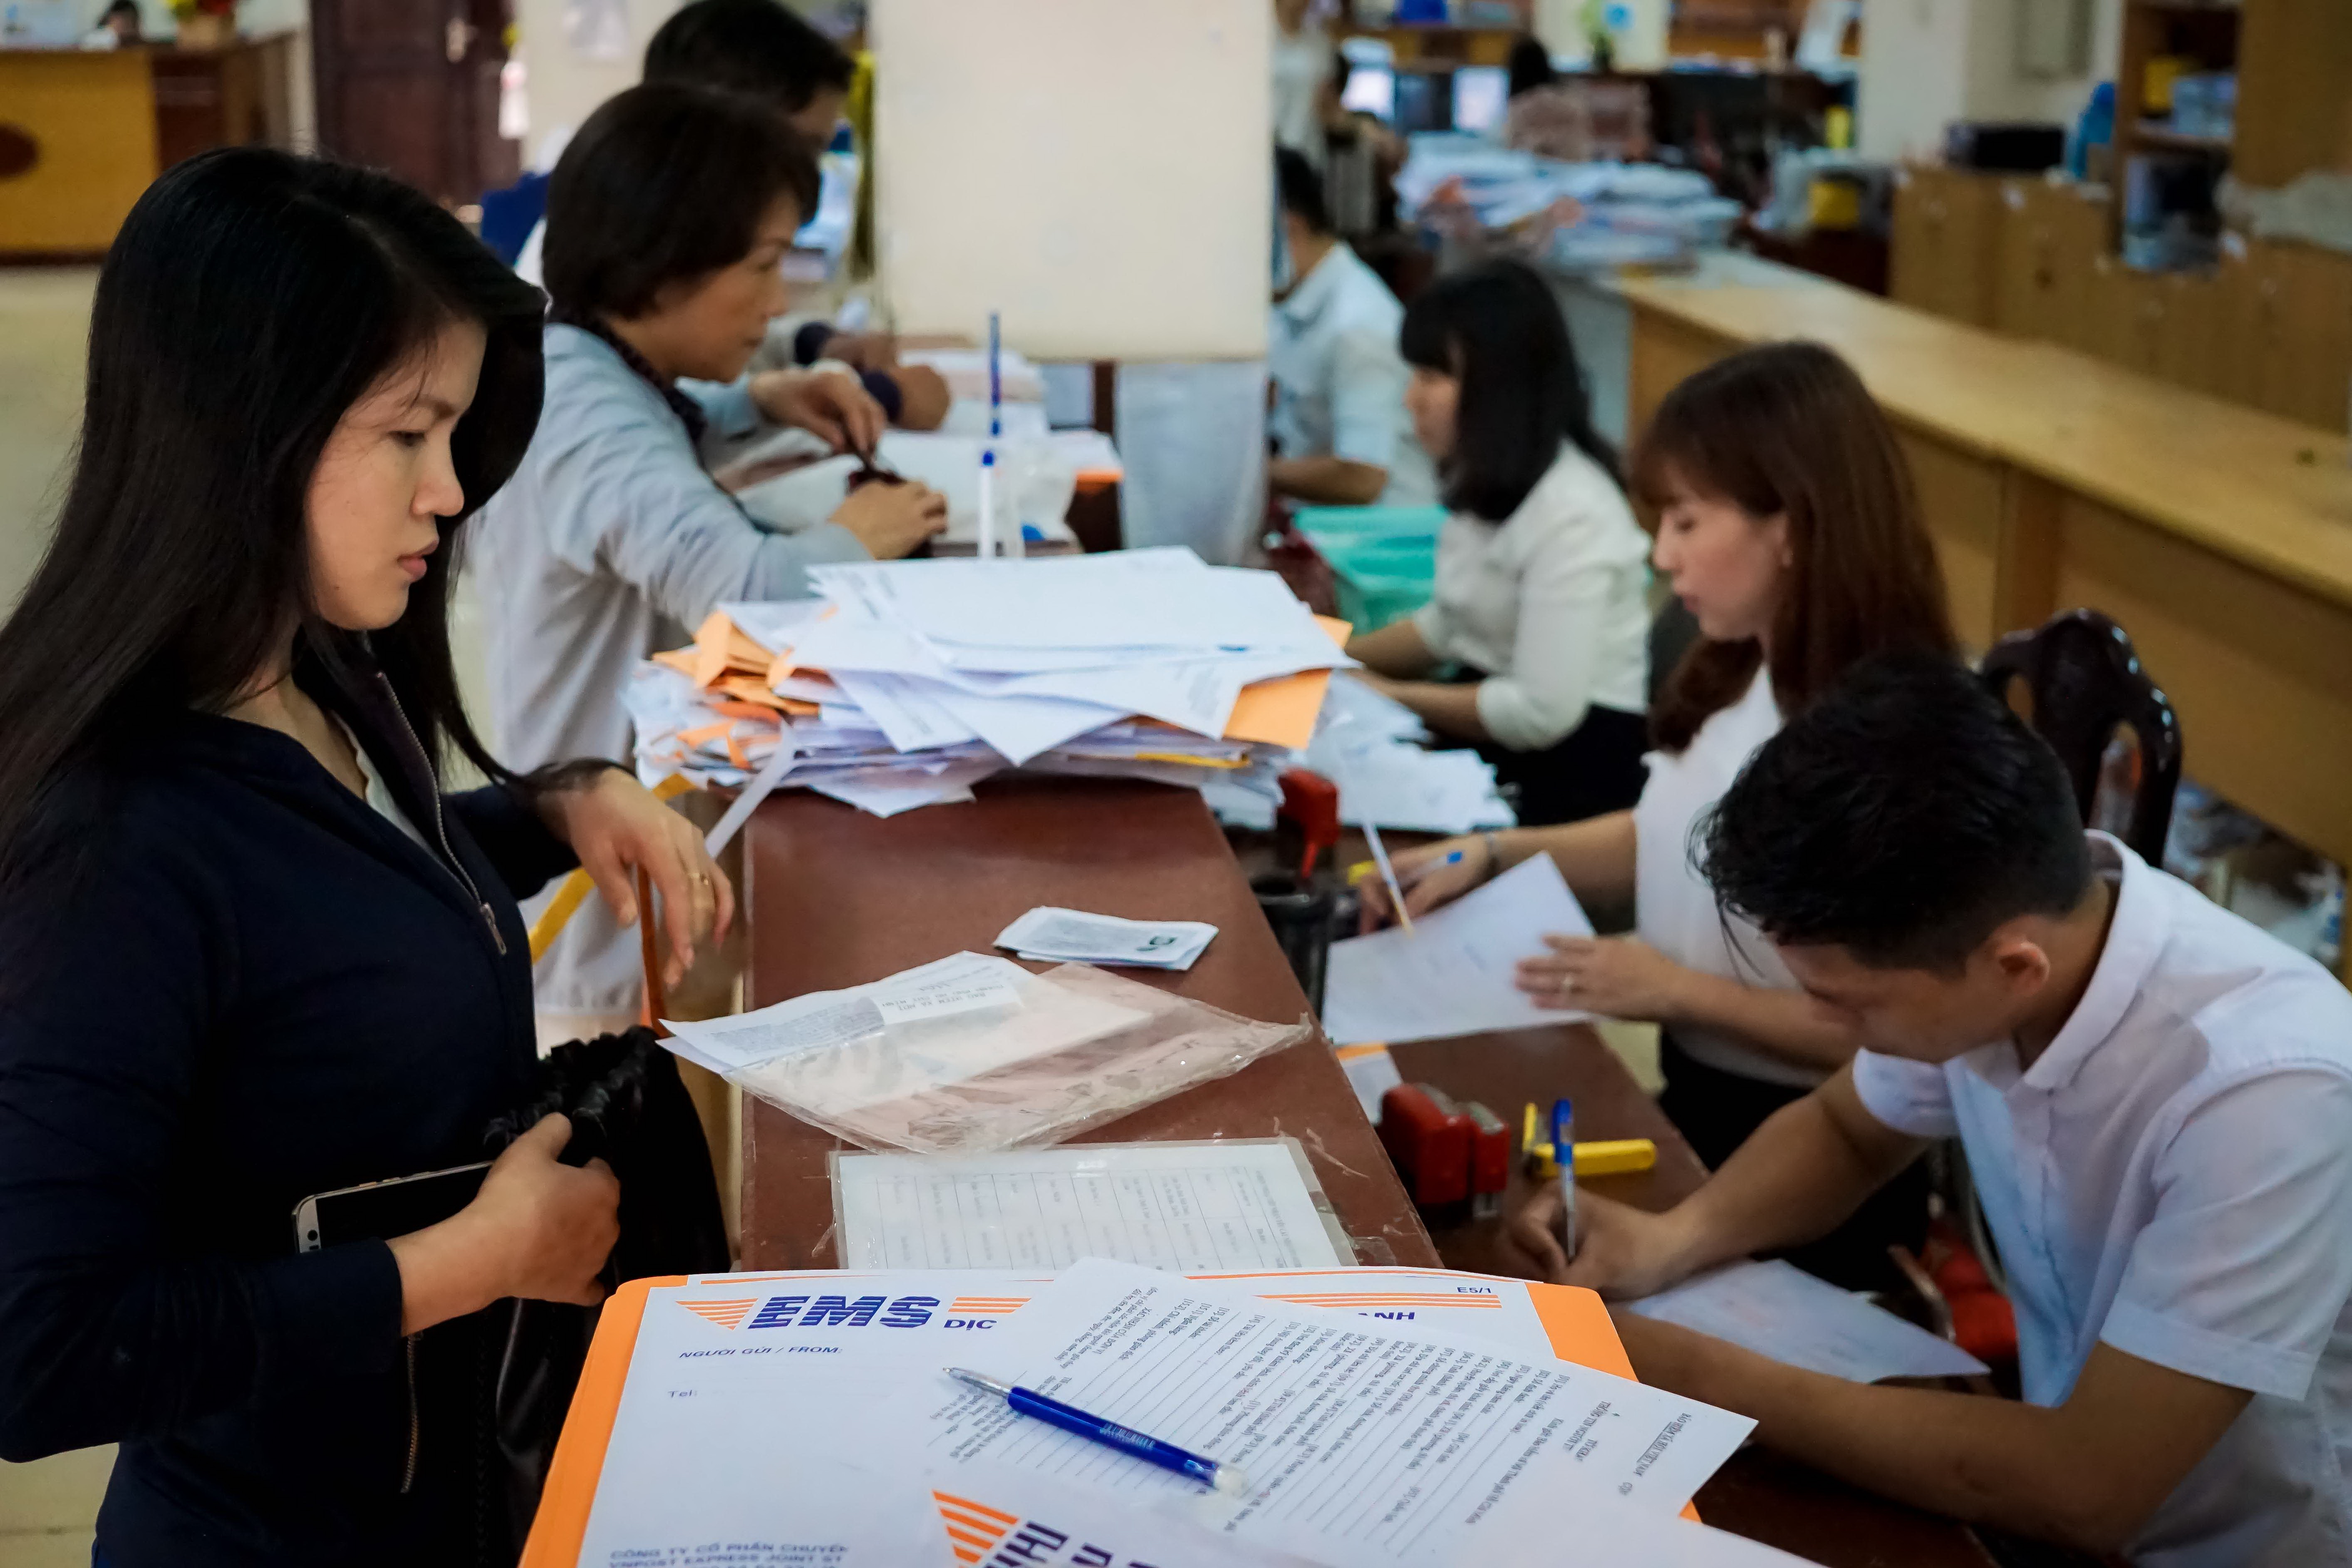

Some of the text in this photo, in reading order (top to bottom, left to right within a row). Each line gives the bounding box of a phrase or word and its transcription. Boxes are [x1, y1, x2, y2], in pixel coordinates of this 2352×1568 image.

[748, 1296, 941, 1329] EMS
[944, 1319, 997, 1330] DỊC
[679, 1348, 736, 1358] NGƯỜI
[742, 1346, 772, 1355] GỬI
